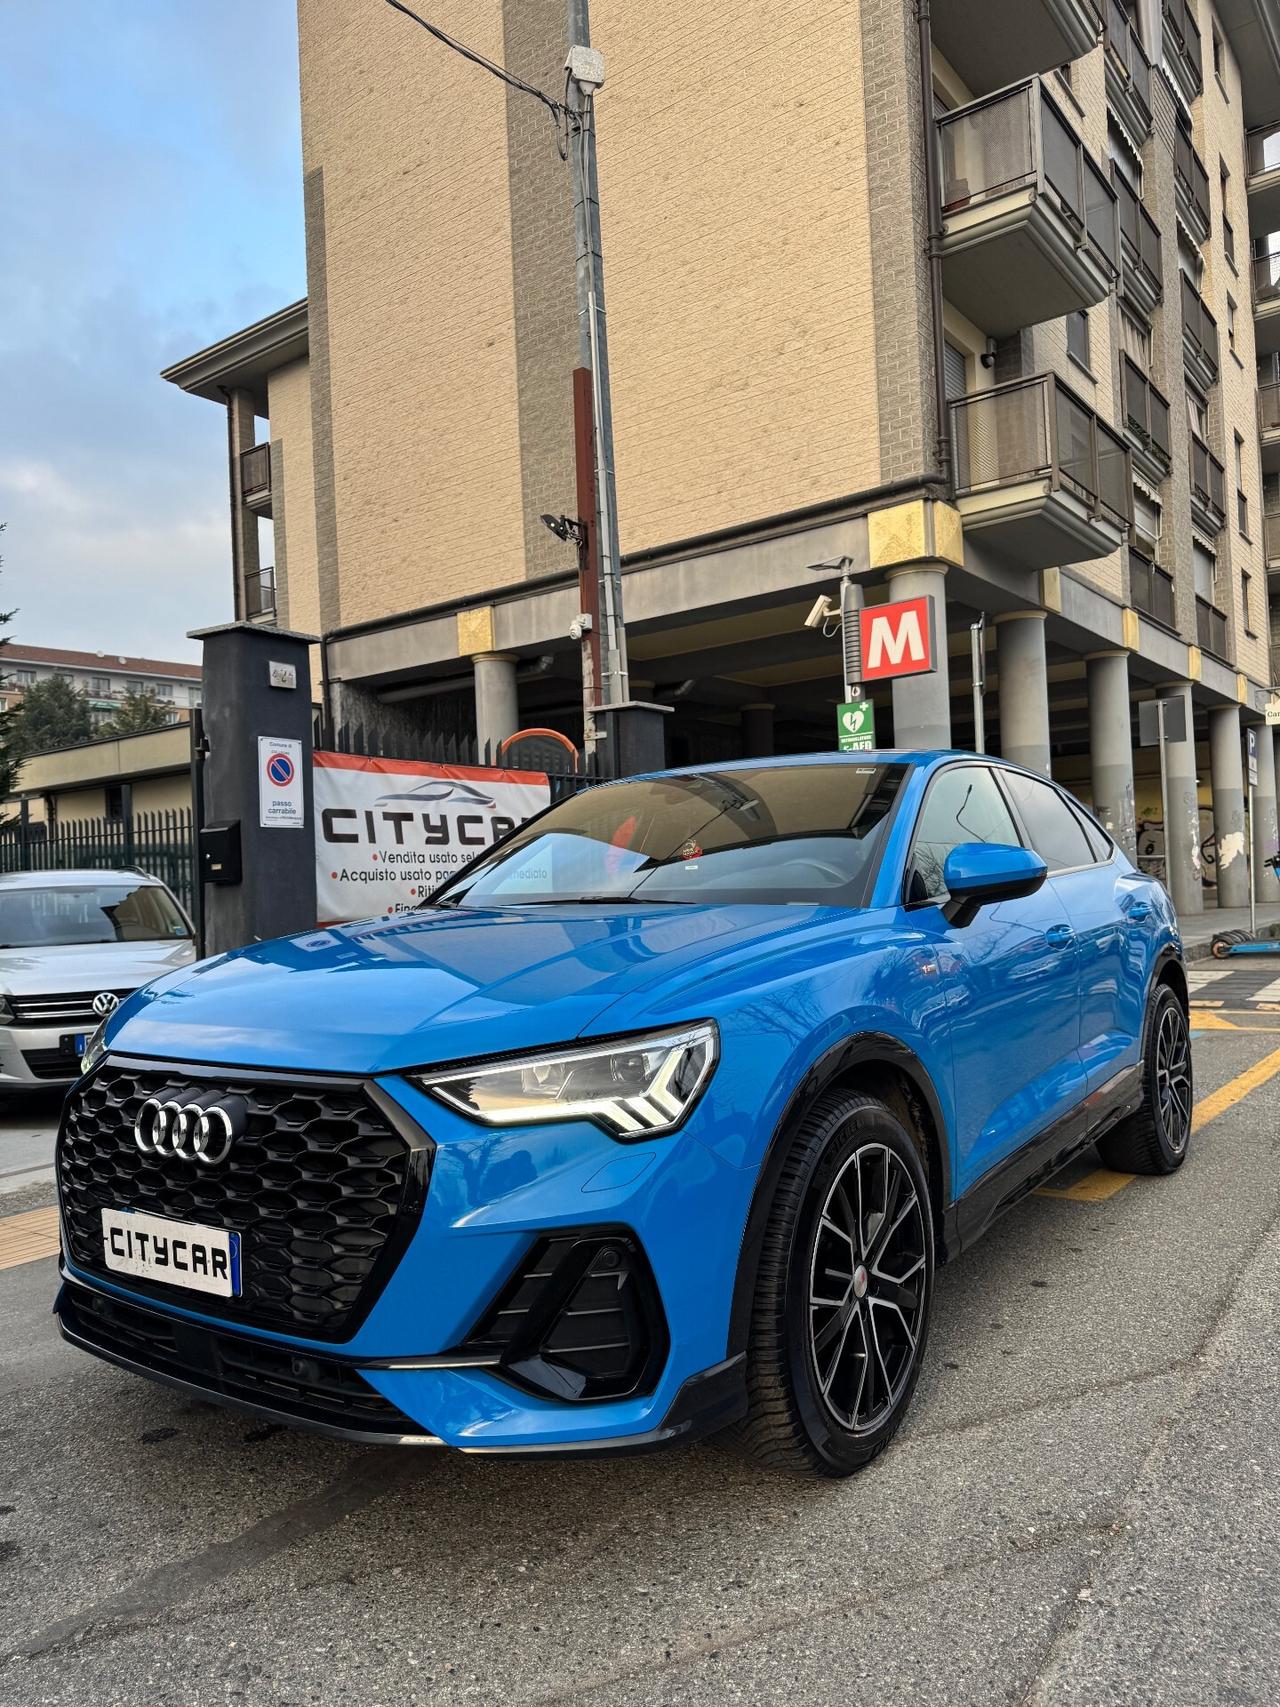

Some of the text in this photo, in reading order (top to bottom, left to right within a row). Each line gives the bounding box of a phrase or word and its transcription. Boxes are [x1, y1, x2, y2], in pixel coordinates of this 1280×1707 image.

[867, 610, 926, 669] M
[267, 807, 297, 815] carrabile
[321, 808, 531, 846] CITYCA
[378, 851, 480, 864] Vendita usato sel
[339, 868, 397, 884] Acquisto
[400, 868, 432, 881] usato
[417, 885, 439, 898] Riti
[110, 1227, 228, 1280] CITYCAR
